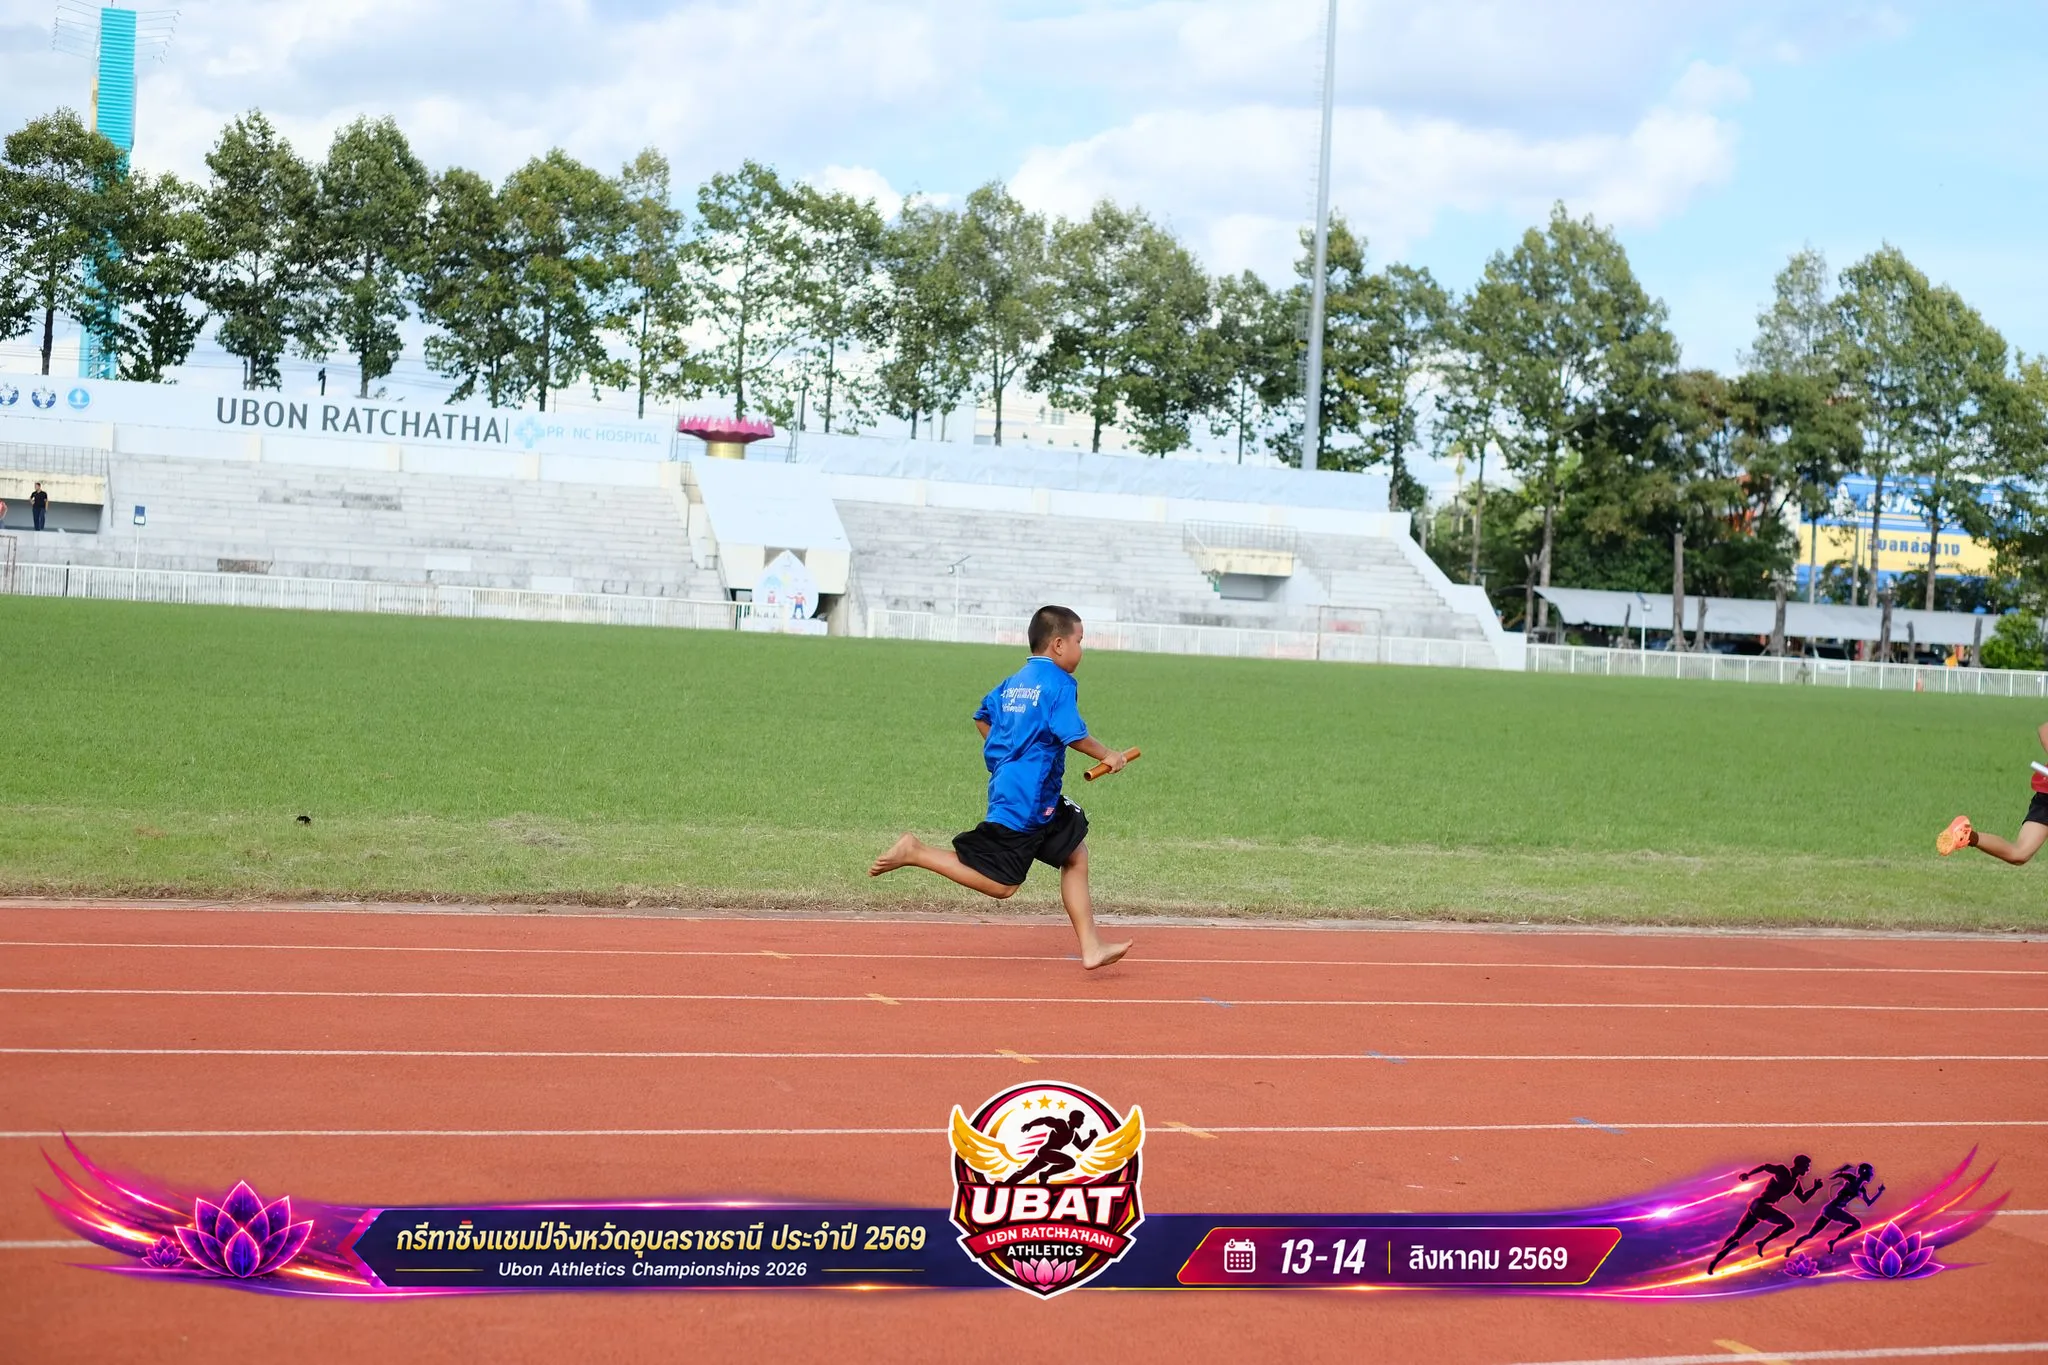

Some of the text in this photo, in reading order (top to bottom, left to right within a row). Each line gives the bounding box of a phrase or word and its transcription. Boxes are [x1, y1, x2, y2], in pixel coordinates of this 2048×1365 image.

[217, 397, 508, 444] UBON RATCHATHA
[546, 425, 591, 440] PRNC
[596, 429, 661, 445] HOSPITAL
